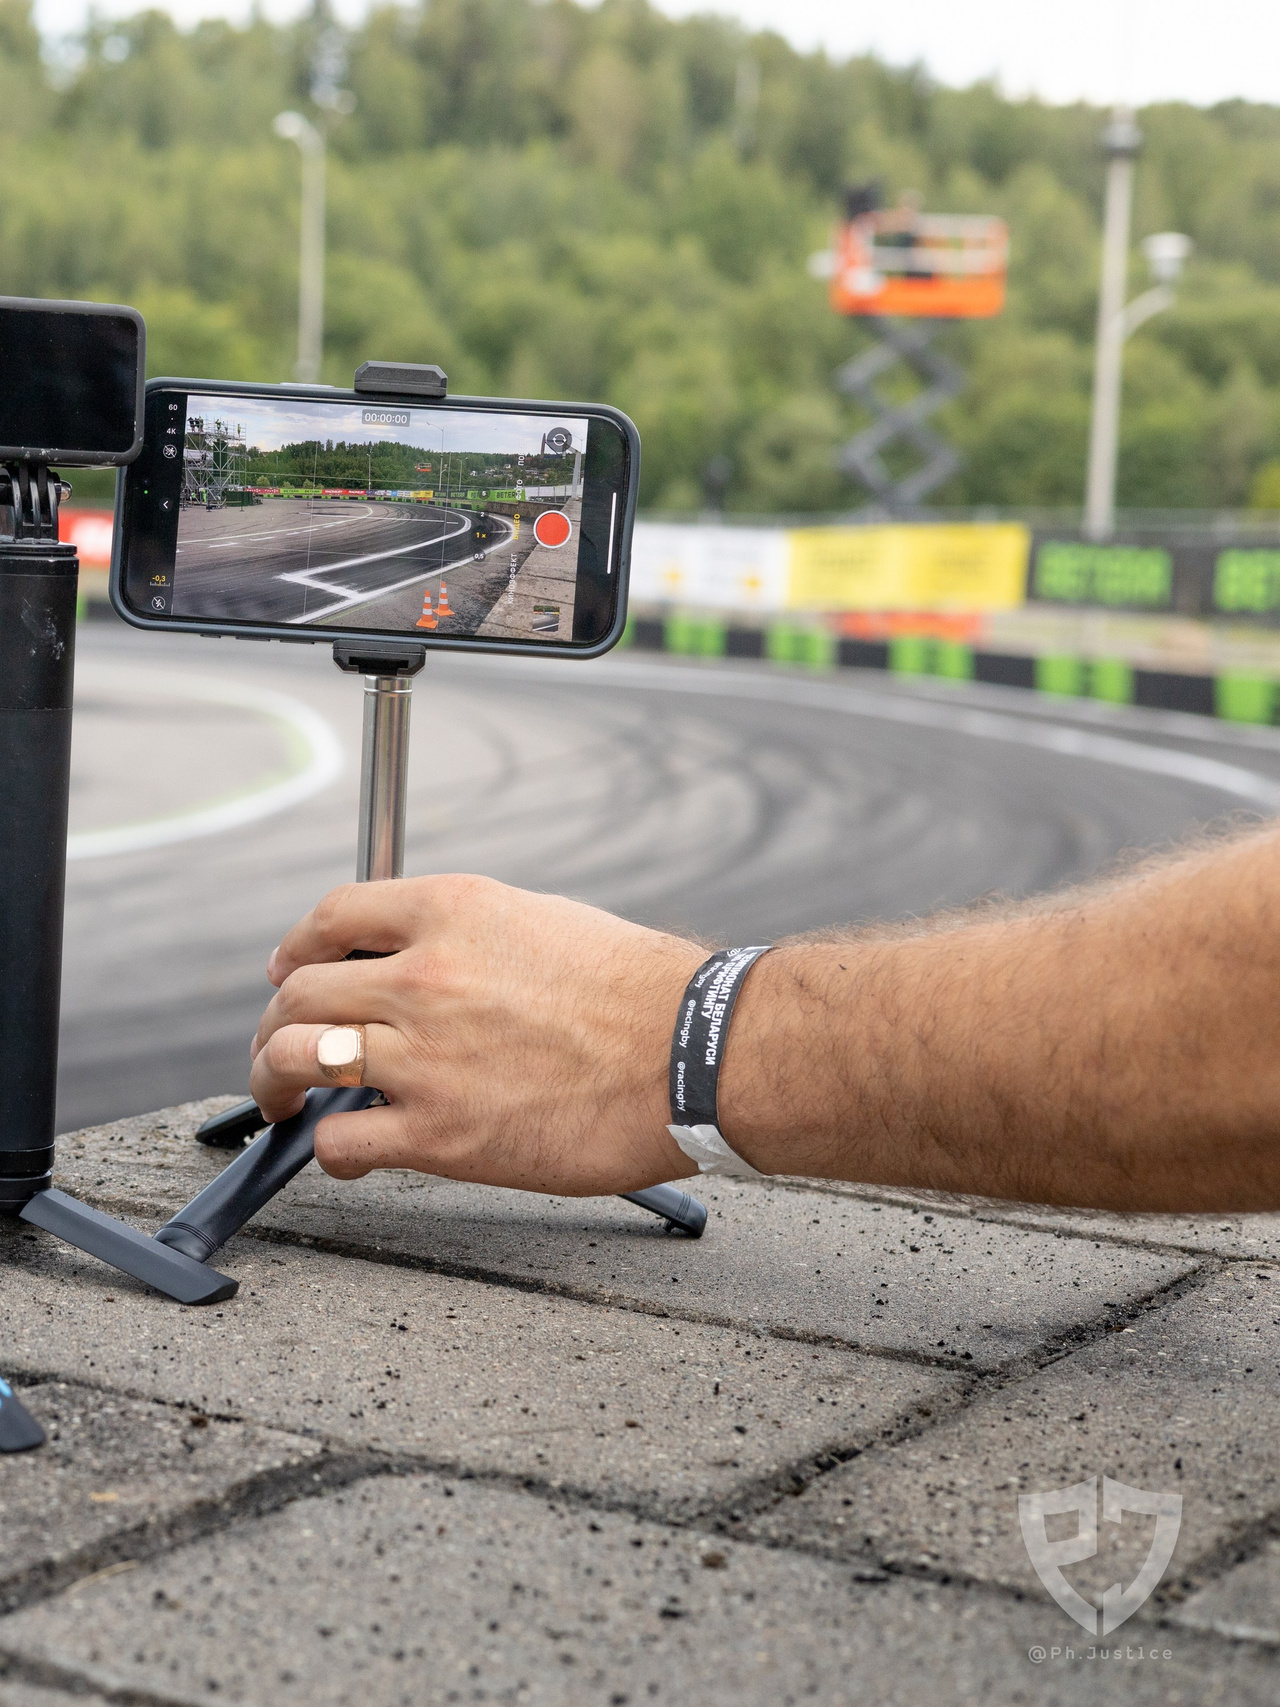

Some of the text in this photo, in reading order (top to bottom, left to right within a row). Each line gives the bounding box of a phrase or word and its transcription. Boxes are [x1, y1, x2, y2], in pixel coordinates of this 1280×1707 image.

[168, 403, 179, 411] 60
[364, 412, 408, 424] 00:00:00
[679, 999, 697, 1048] @racingby
[705, 1003, 727, 1066] БЕЛАРУСИ
[676, 1061, 686, 1112] @racingby
